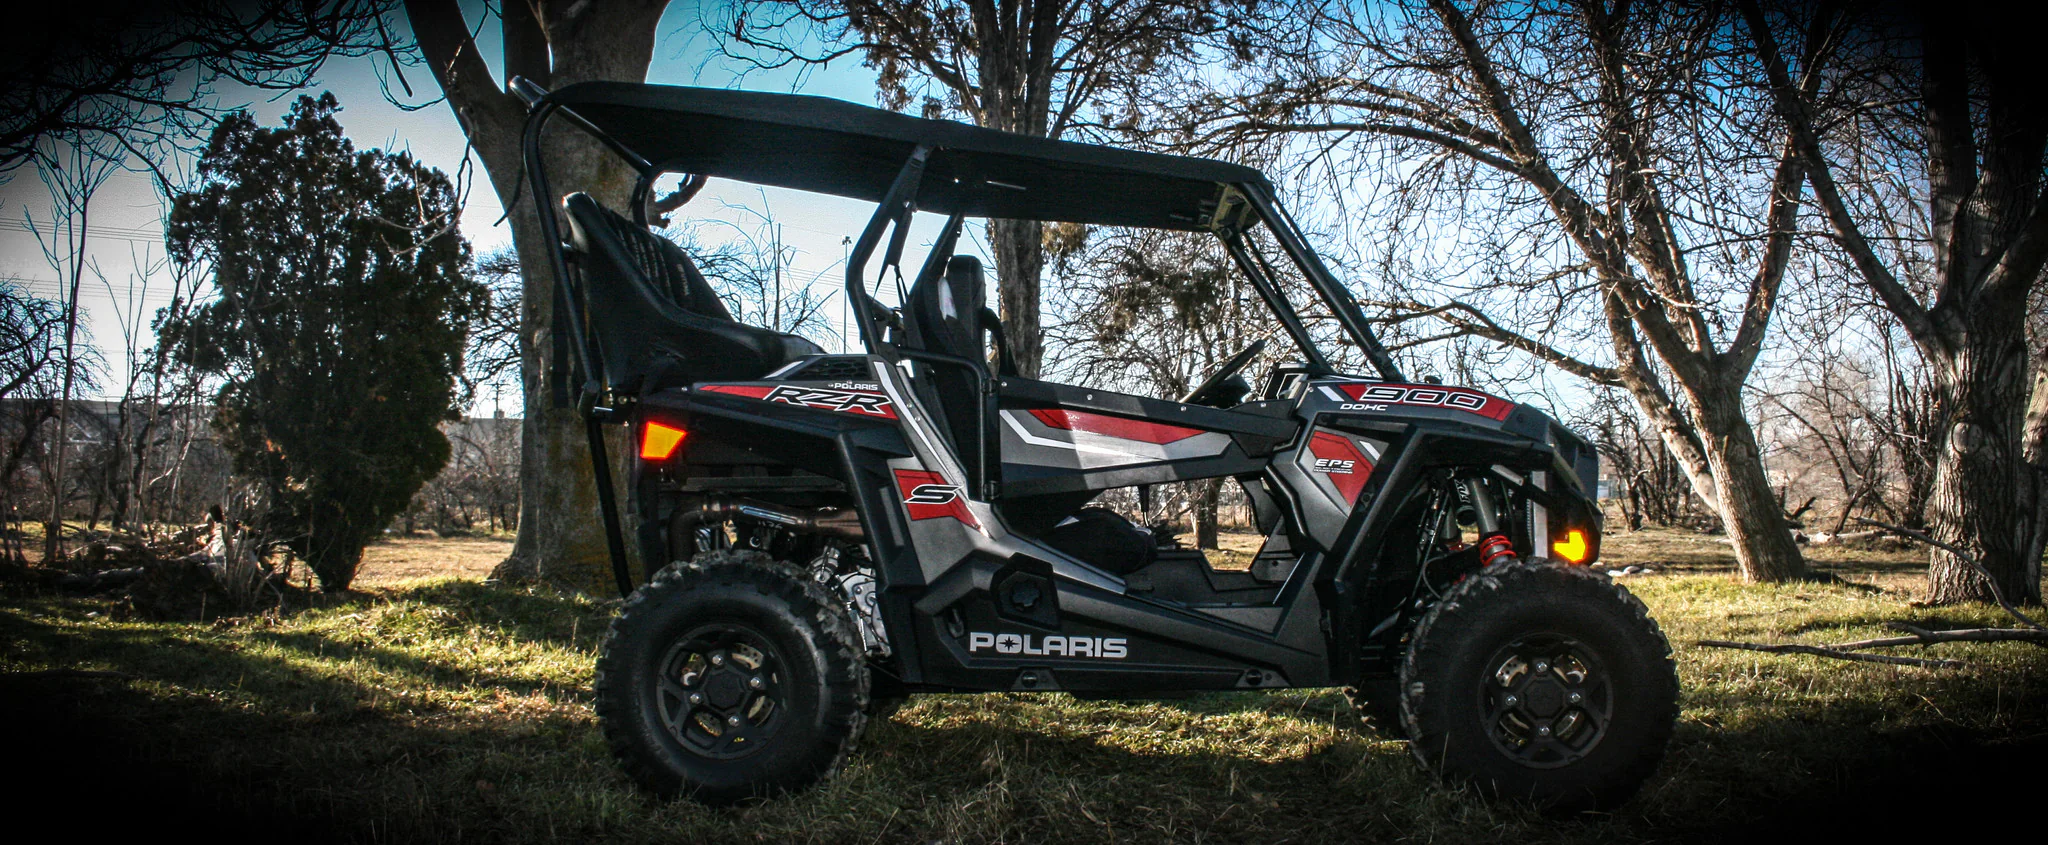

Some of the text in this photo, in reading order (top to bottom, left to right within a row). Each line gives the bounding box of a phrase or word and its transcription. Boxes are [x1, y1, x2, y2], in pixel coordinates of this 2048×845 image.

[834, 382, 878, 391] POLARIS
[762, 384, 893, 415] RZR
[1340, 403, 1388, 411] DOHC
[1358, 386, 1488, 411] 900
[1314, 458, 1355, 468] EPS
[903, 484, 965, 504] S
[969, 631, 1128, 659] POLARIS
